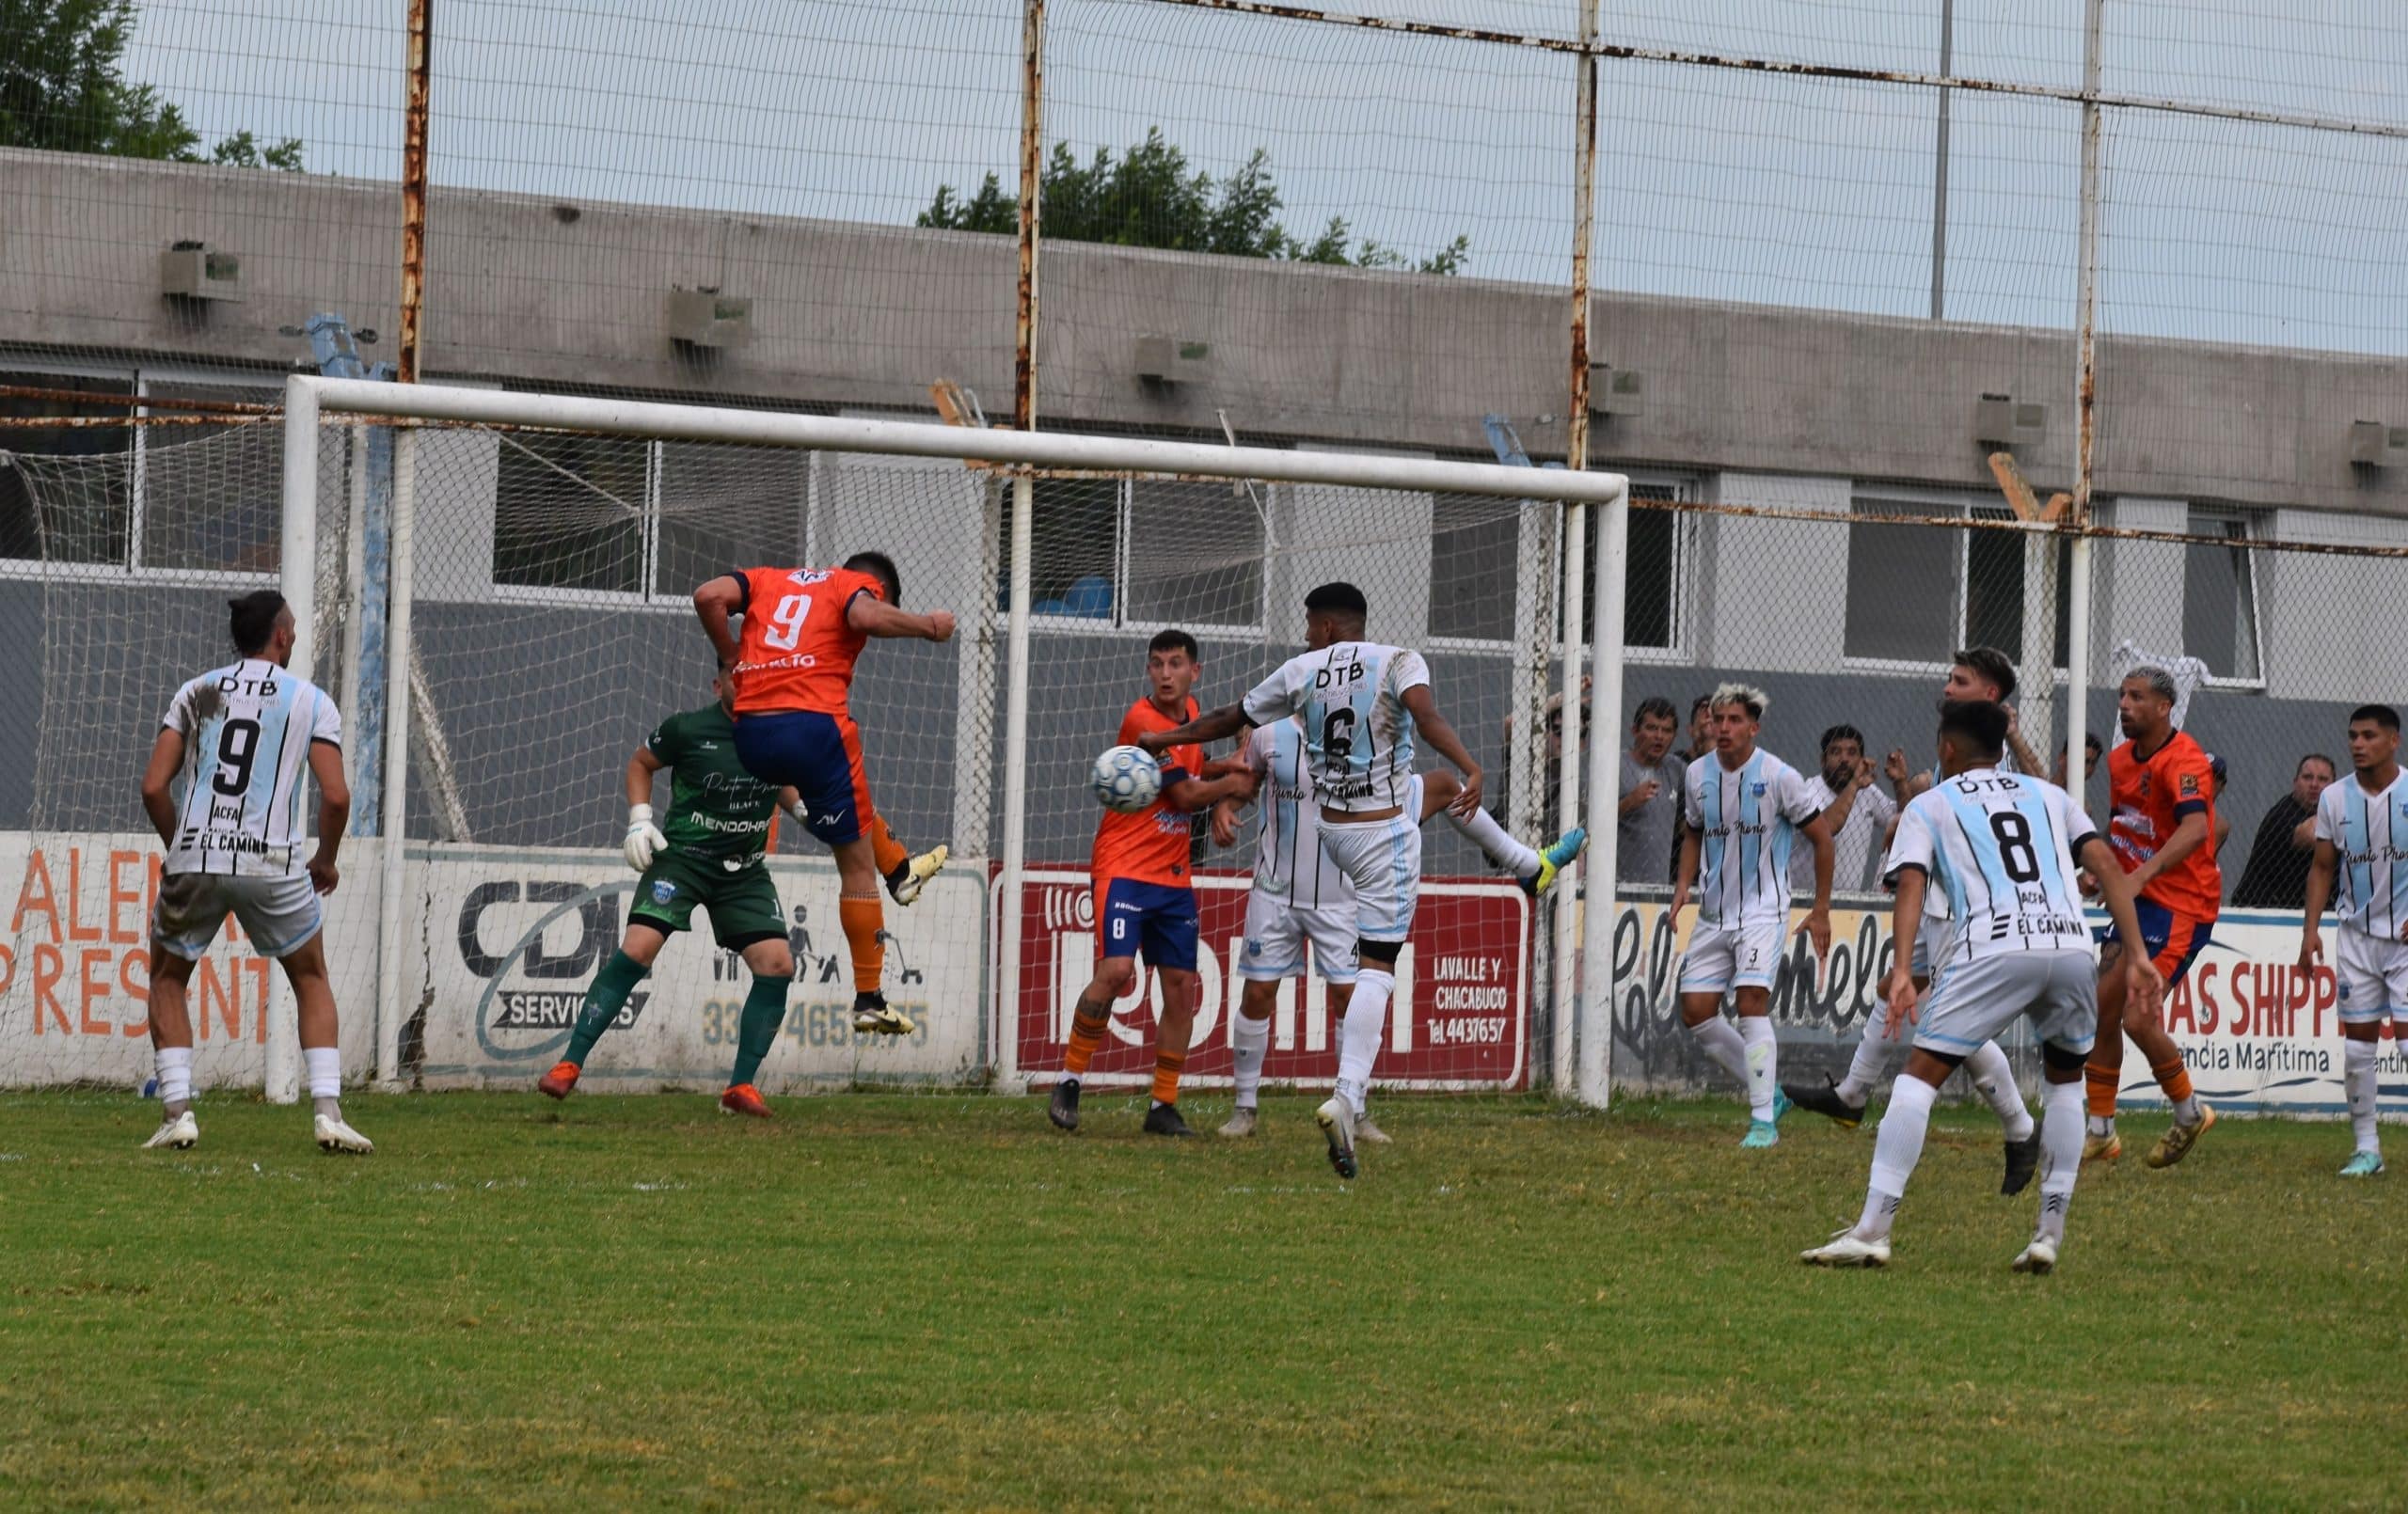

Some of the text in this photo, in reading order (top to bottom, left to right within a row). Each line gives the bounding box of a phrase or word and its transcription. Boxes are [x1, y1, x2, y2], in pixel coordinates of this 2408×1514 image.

[765, 594, 813, 651] 9
[1315, 662, 1364, 688] DTB
[218, 676, 277, 697] DTB
[1323, 707, 1355, 756] 6
[213, 718, 261, 796] 9
[1956, 778, 2020, 795] DTB
[214, 805, 239, 822] ACFA
[1704, 824, 1730, 838] unto
[200, 833, 215, 851] EL
[1990, 812, 2041, 884] 8
[2382, 844, 2408, 862] Pho
[1113, 918, 1126, 939] 8
[2018, 919, 2034, 935] EL
[1749, 948, 1758, 965] 3
[1434, 957, 1501, 982] LAVALLE Y
[1435, 986, 1507, 1010] CHACABUCO
[510, 995, 634, 1025] SERVIS
